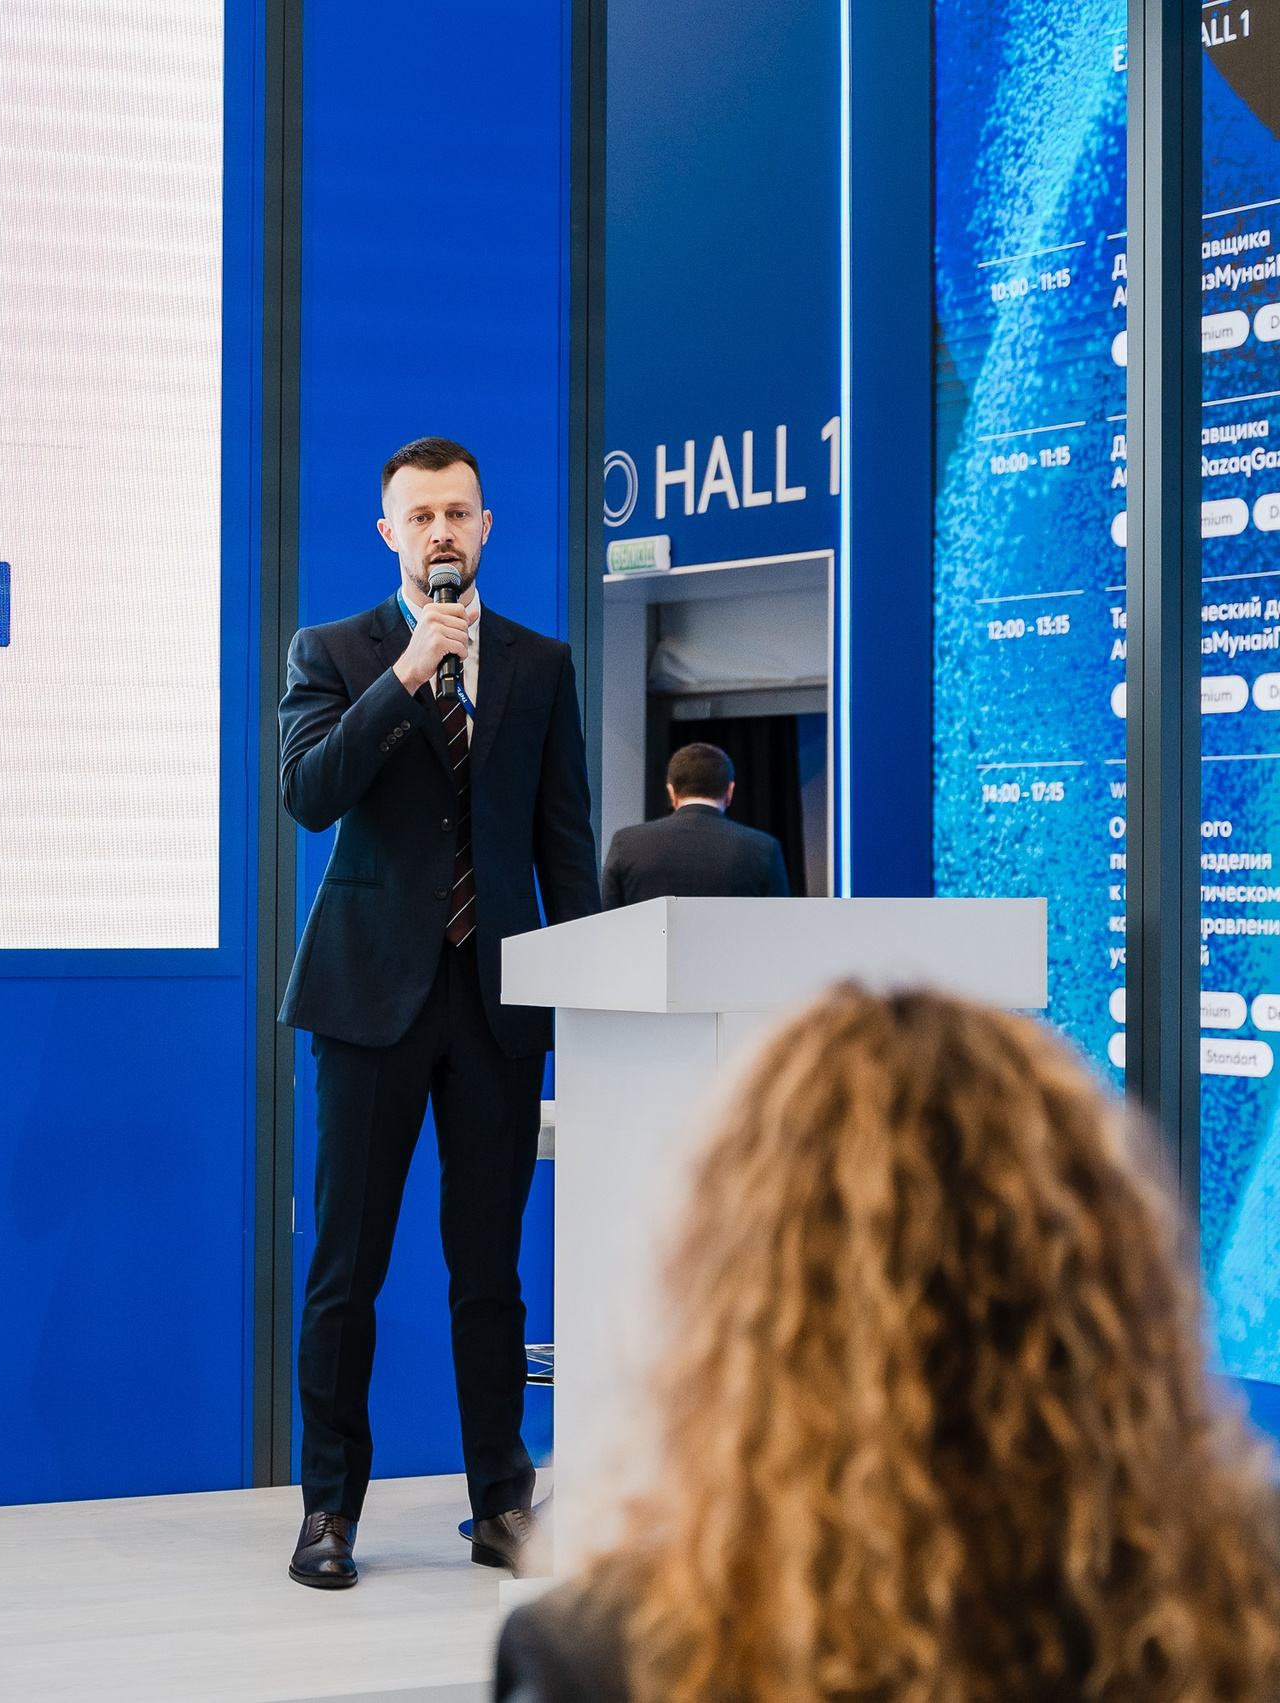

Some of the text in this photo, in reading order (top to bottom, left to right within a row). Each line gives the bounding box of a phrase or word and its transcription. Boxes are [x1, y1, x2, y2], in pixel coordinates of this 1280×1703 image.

[1240, 9, 1250, 38] 1
[990, 277, 1029, 302] 10:00
[1040, 267, 1071, 292] 11:15
[656, 416, 840, 519] HALL 1
[989, 451, 1029, 475] 10:00
[1039, 445, 1071, 468] 11:15
[987, 618, 1025, 640] 12:00
[1036, 614, 1070, 636] 13:15
[982, 783, 1020, 803] 14:00
[1031, 781, 1065, 802] 17:15
